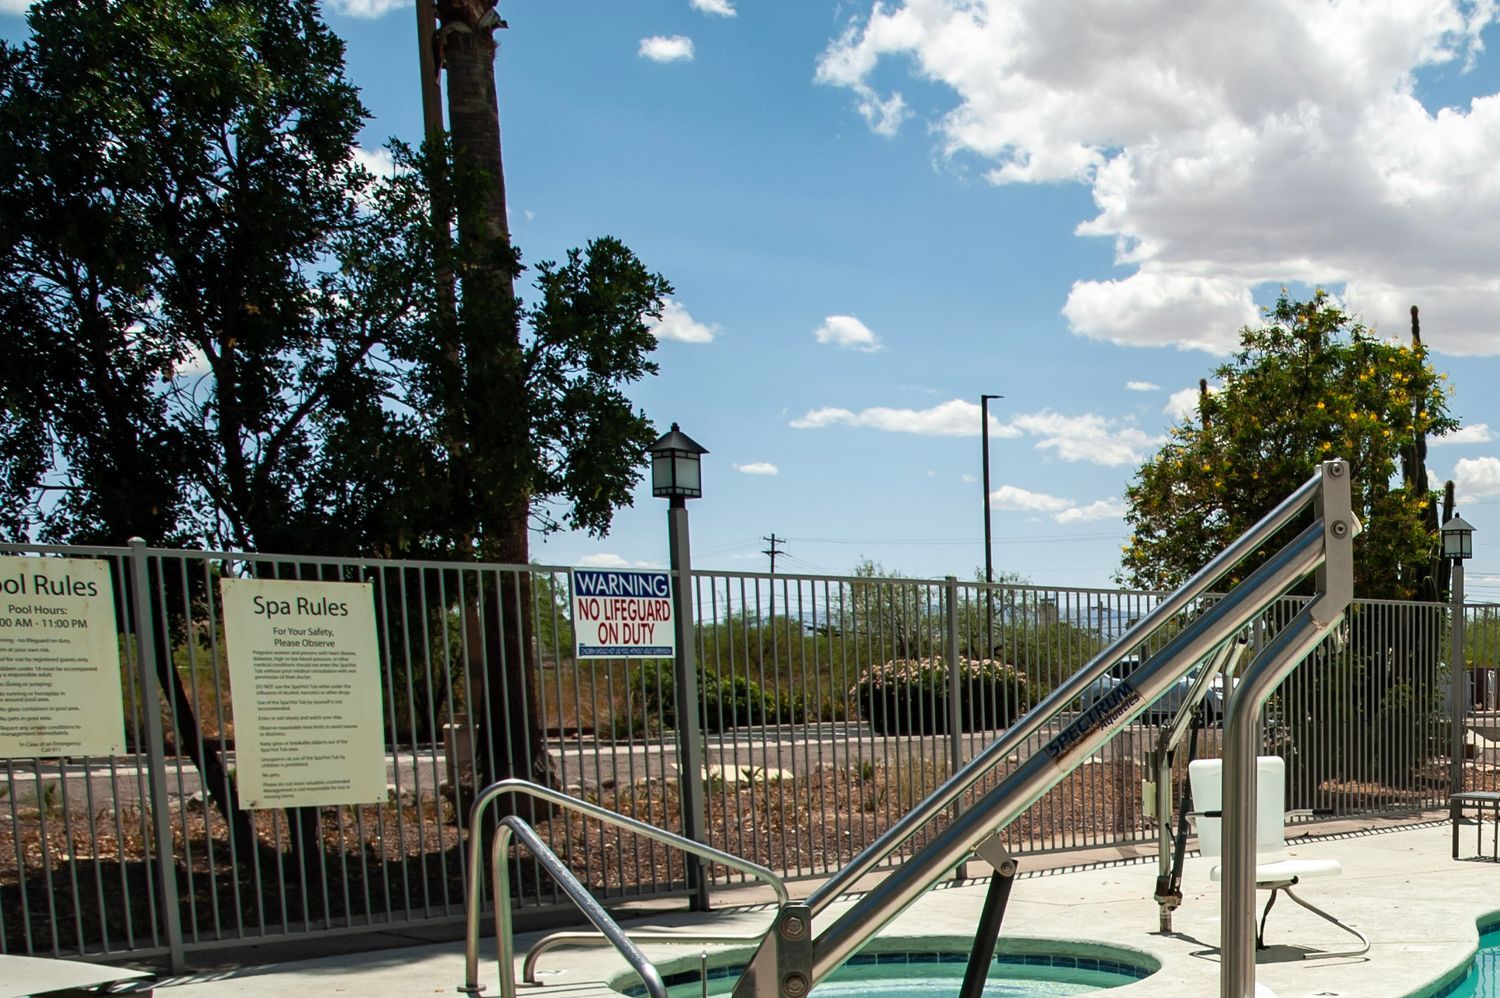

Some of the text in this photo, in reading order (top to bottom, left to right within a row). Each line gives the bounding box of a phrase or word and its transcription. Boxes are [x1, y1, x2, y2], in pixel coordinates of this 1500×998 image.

[0, 573, 98, 597] ol Rules
[577, 573, 668, 596] WARNING
[8, 604, 68, 615] Pool Hours:
[253, 595, 349, 619] Spa Rules
[578, 598, 671, 621] NO LIFEGUARD
[15, 618, 33, 628] AM
[42, 619, 70, 628] 11:00
[72, 619, 88, 628] PM
[273, 627, 286, 635] For
[288, 628, 306, 636] Your
[597, 622, 655, 645] ON DUTY
[274, 639, 335, 648] Please Observe
[1048, 683, 1135, 758] SPECTRUM
[1099, 694, 1140, 731] Aquatics
